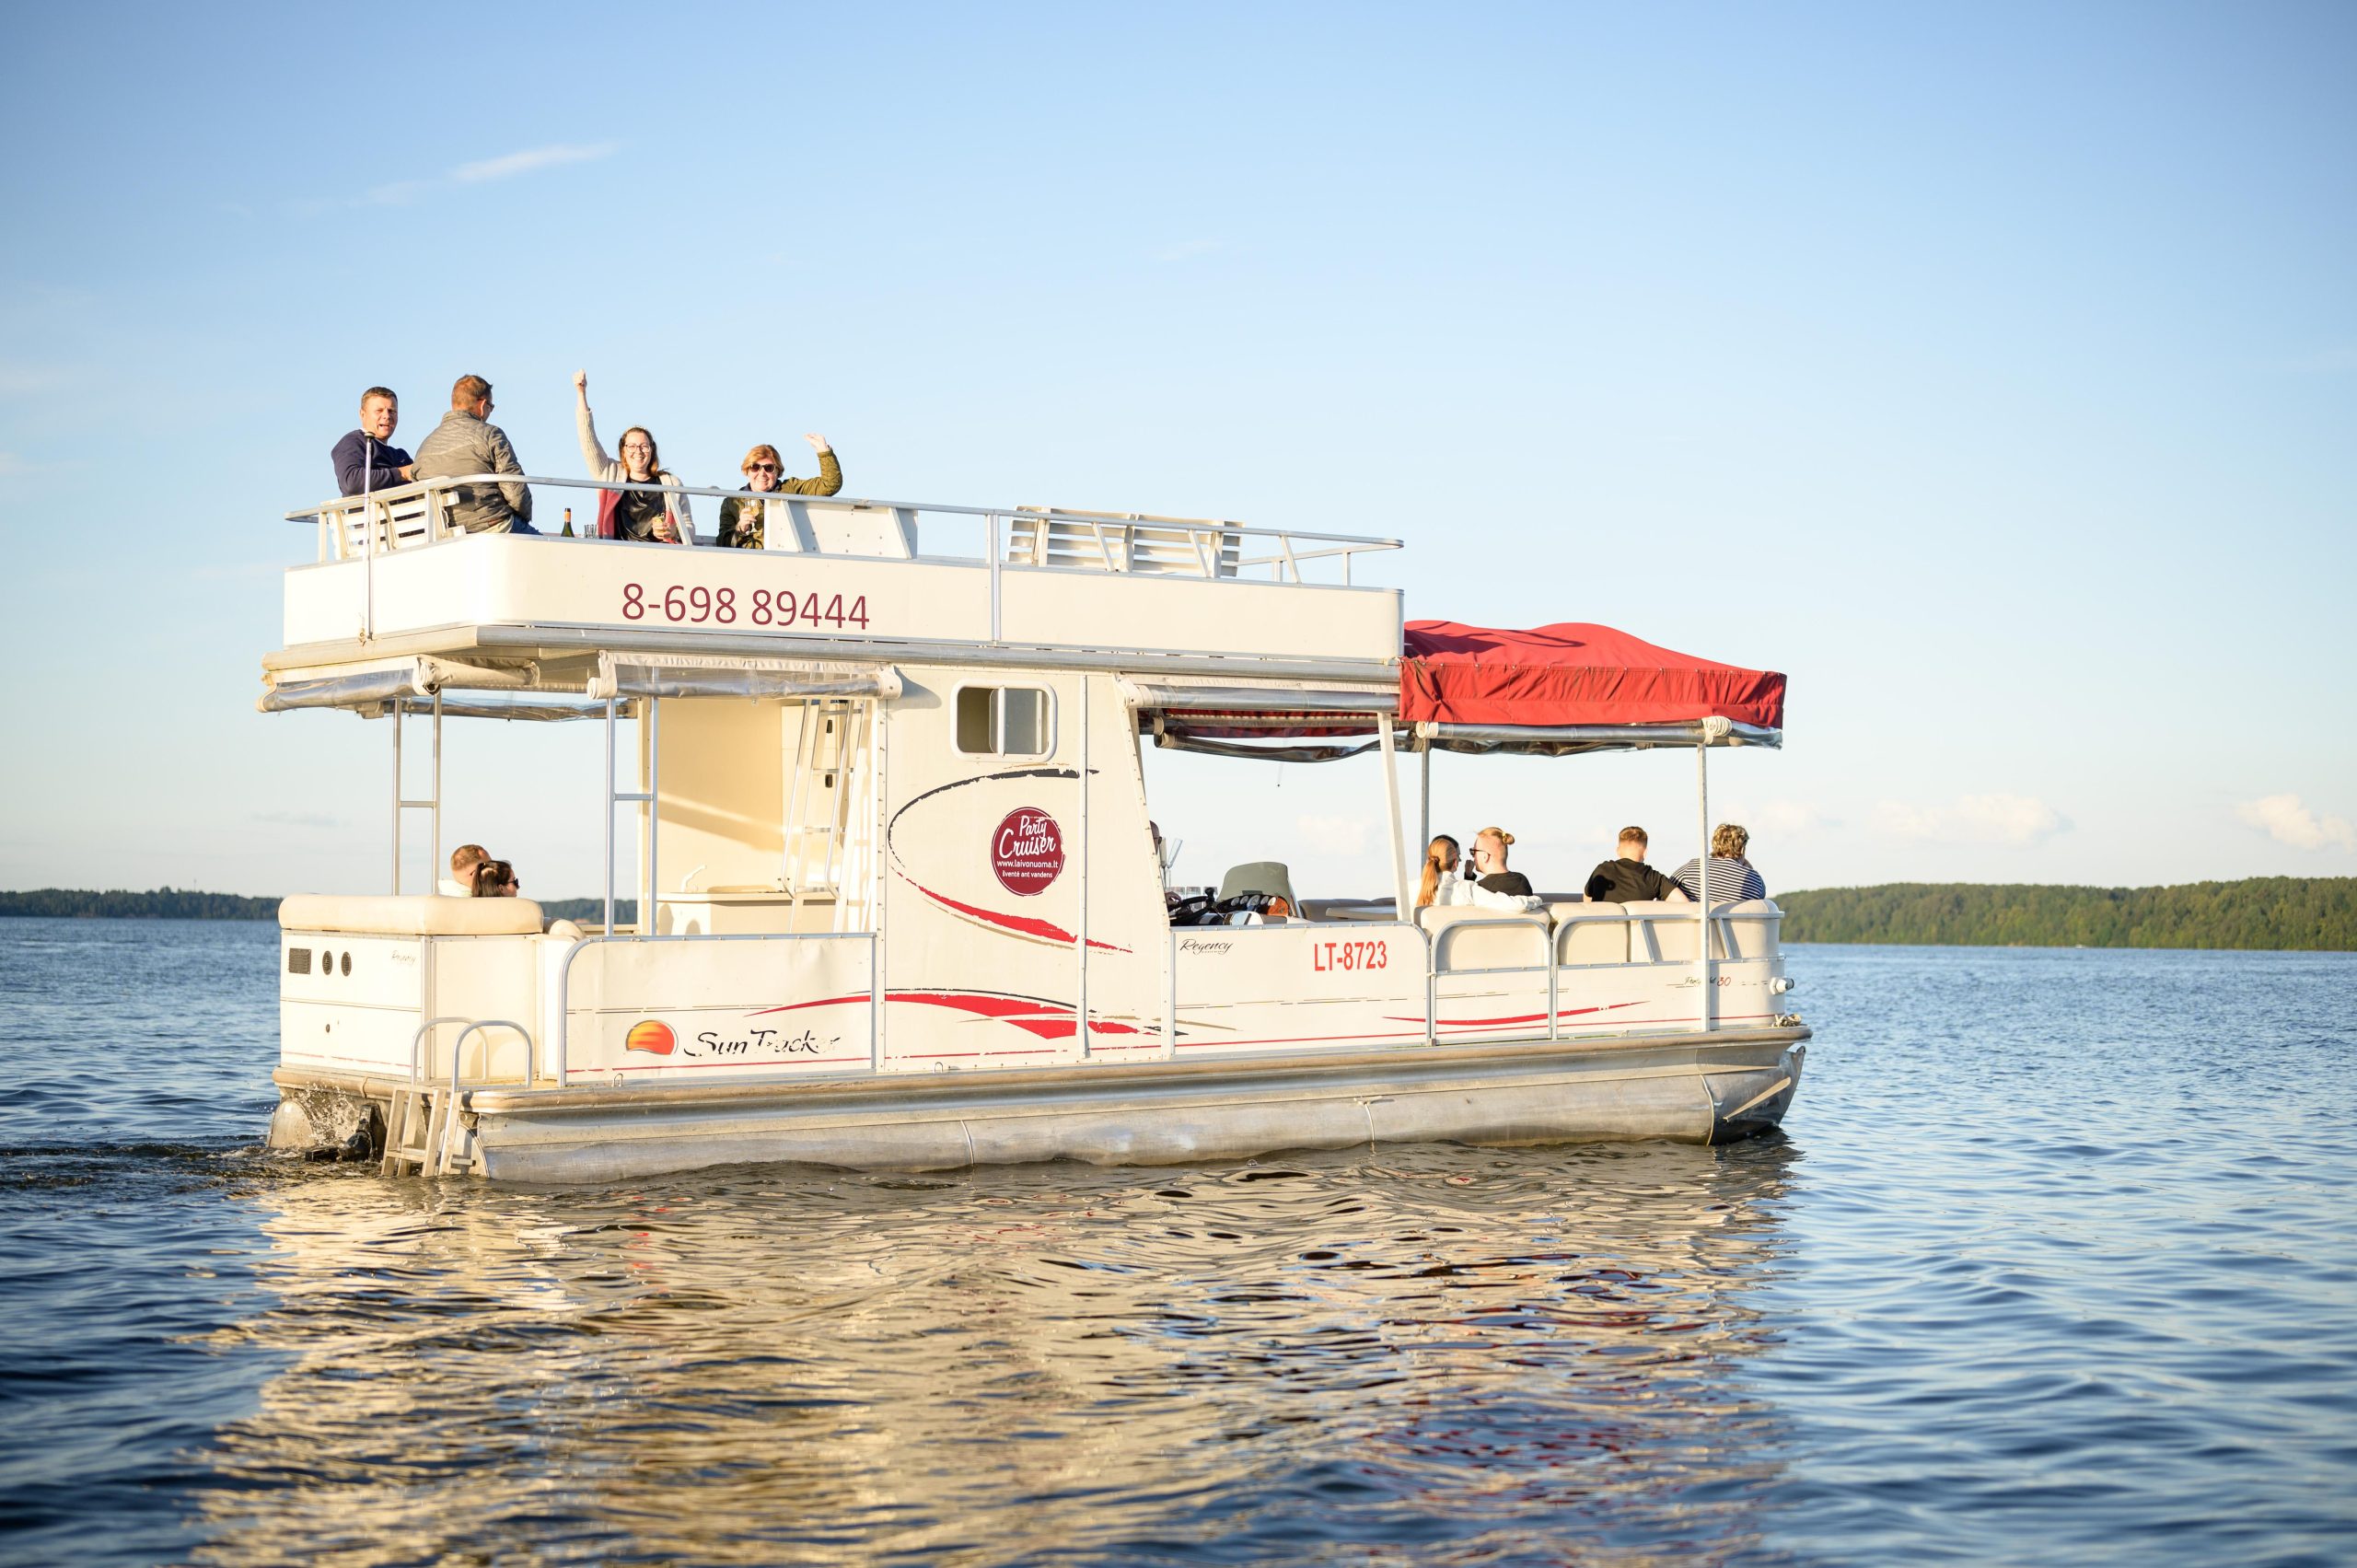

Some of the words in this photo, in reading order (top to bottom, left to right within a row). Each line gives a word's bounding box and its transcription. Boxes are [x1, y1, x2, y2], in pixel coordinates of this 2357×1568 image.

[621, 583, 737, 623] 8-698
[751, 589, 869, 630] 89444
[1019, 815, 1048, 839] Party
[999, 829, 1056, 858] Cruiser
[997, 859, 1059, 868] www.laivonuoma.lt
[1179, 938, 1233, 956] Regency
[1314, 940, 1387, 971] LT-8723
[684, 1031, 748, 1057] Sun
[750, 1029, 842, 1054] Tack
